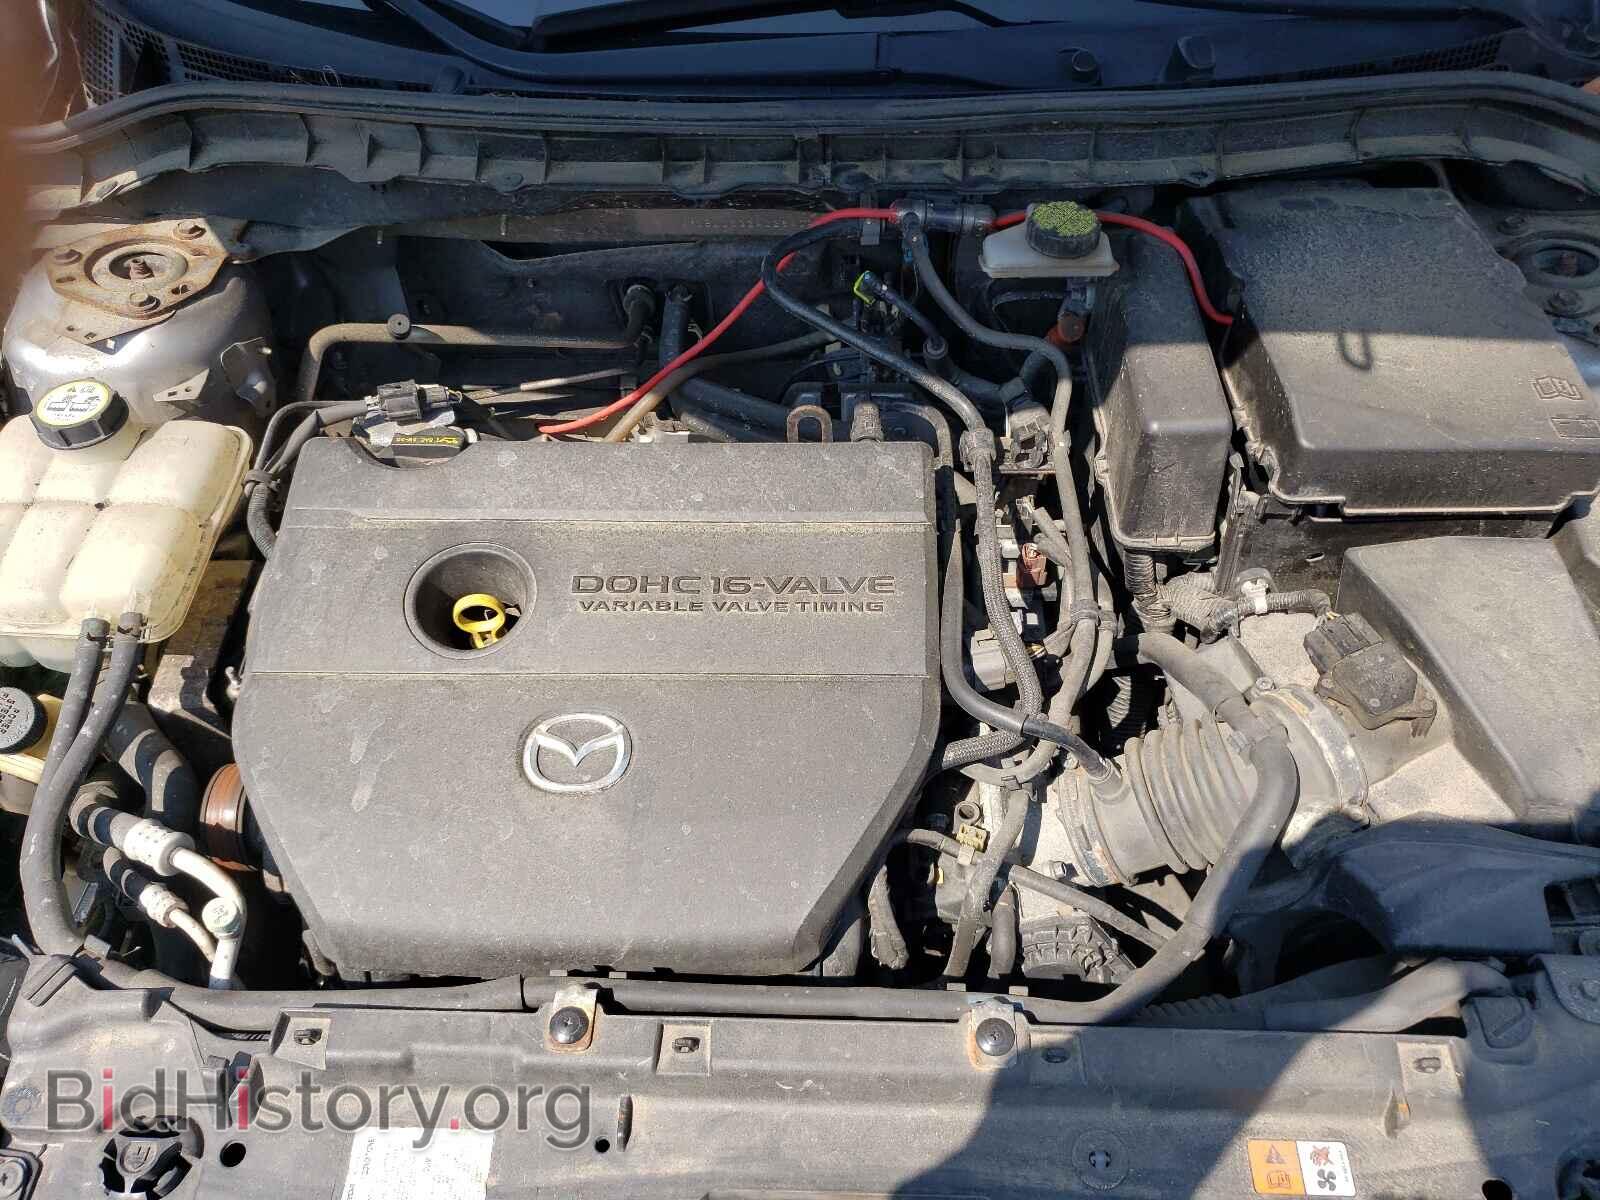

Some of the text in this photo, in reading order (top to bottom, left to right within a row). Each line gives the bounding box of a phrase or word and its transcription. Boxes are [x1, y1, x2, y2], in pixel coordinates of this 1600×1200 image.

[571, 575, 896, 595] DOHC 16-VALVE
[580, 601, 885, 613] VARIABLE VALVE TIMING
